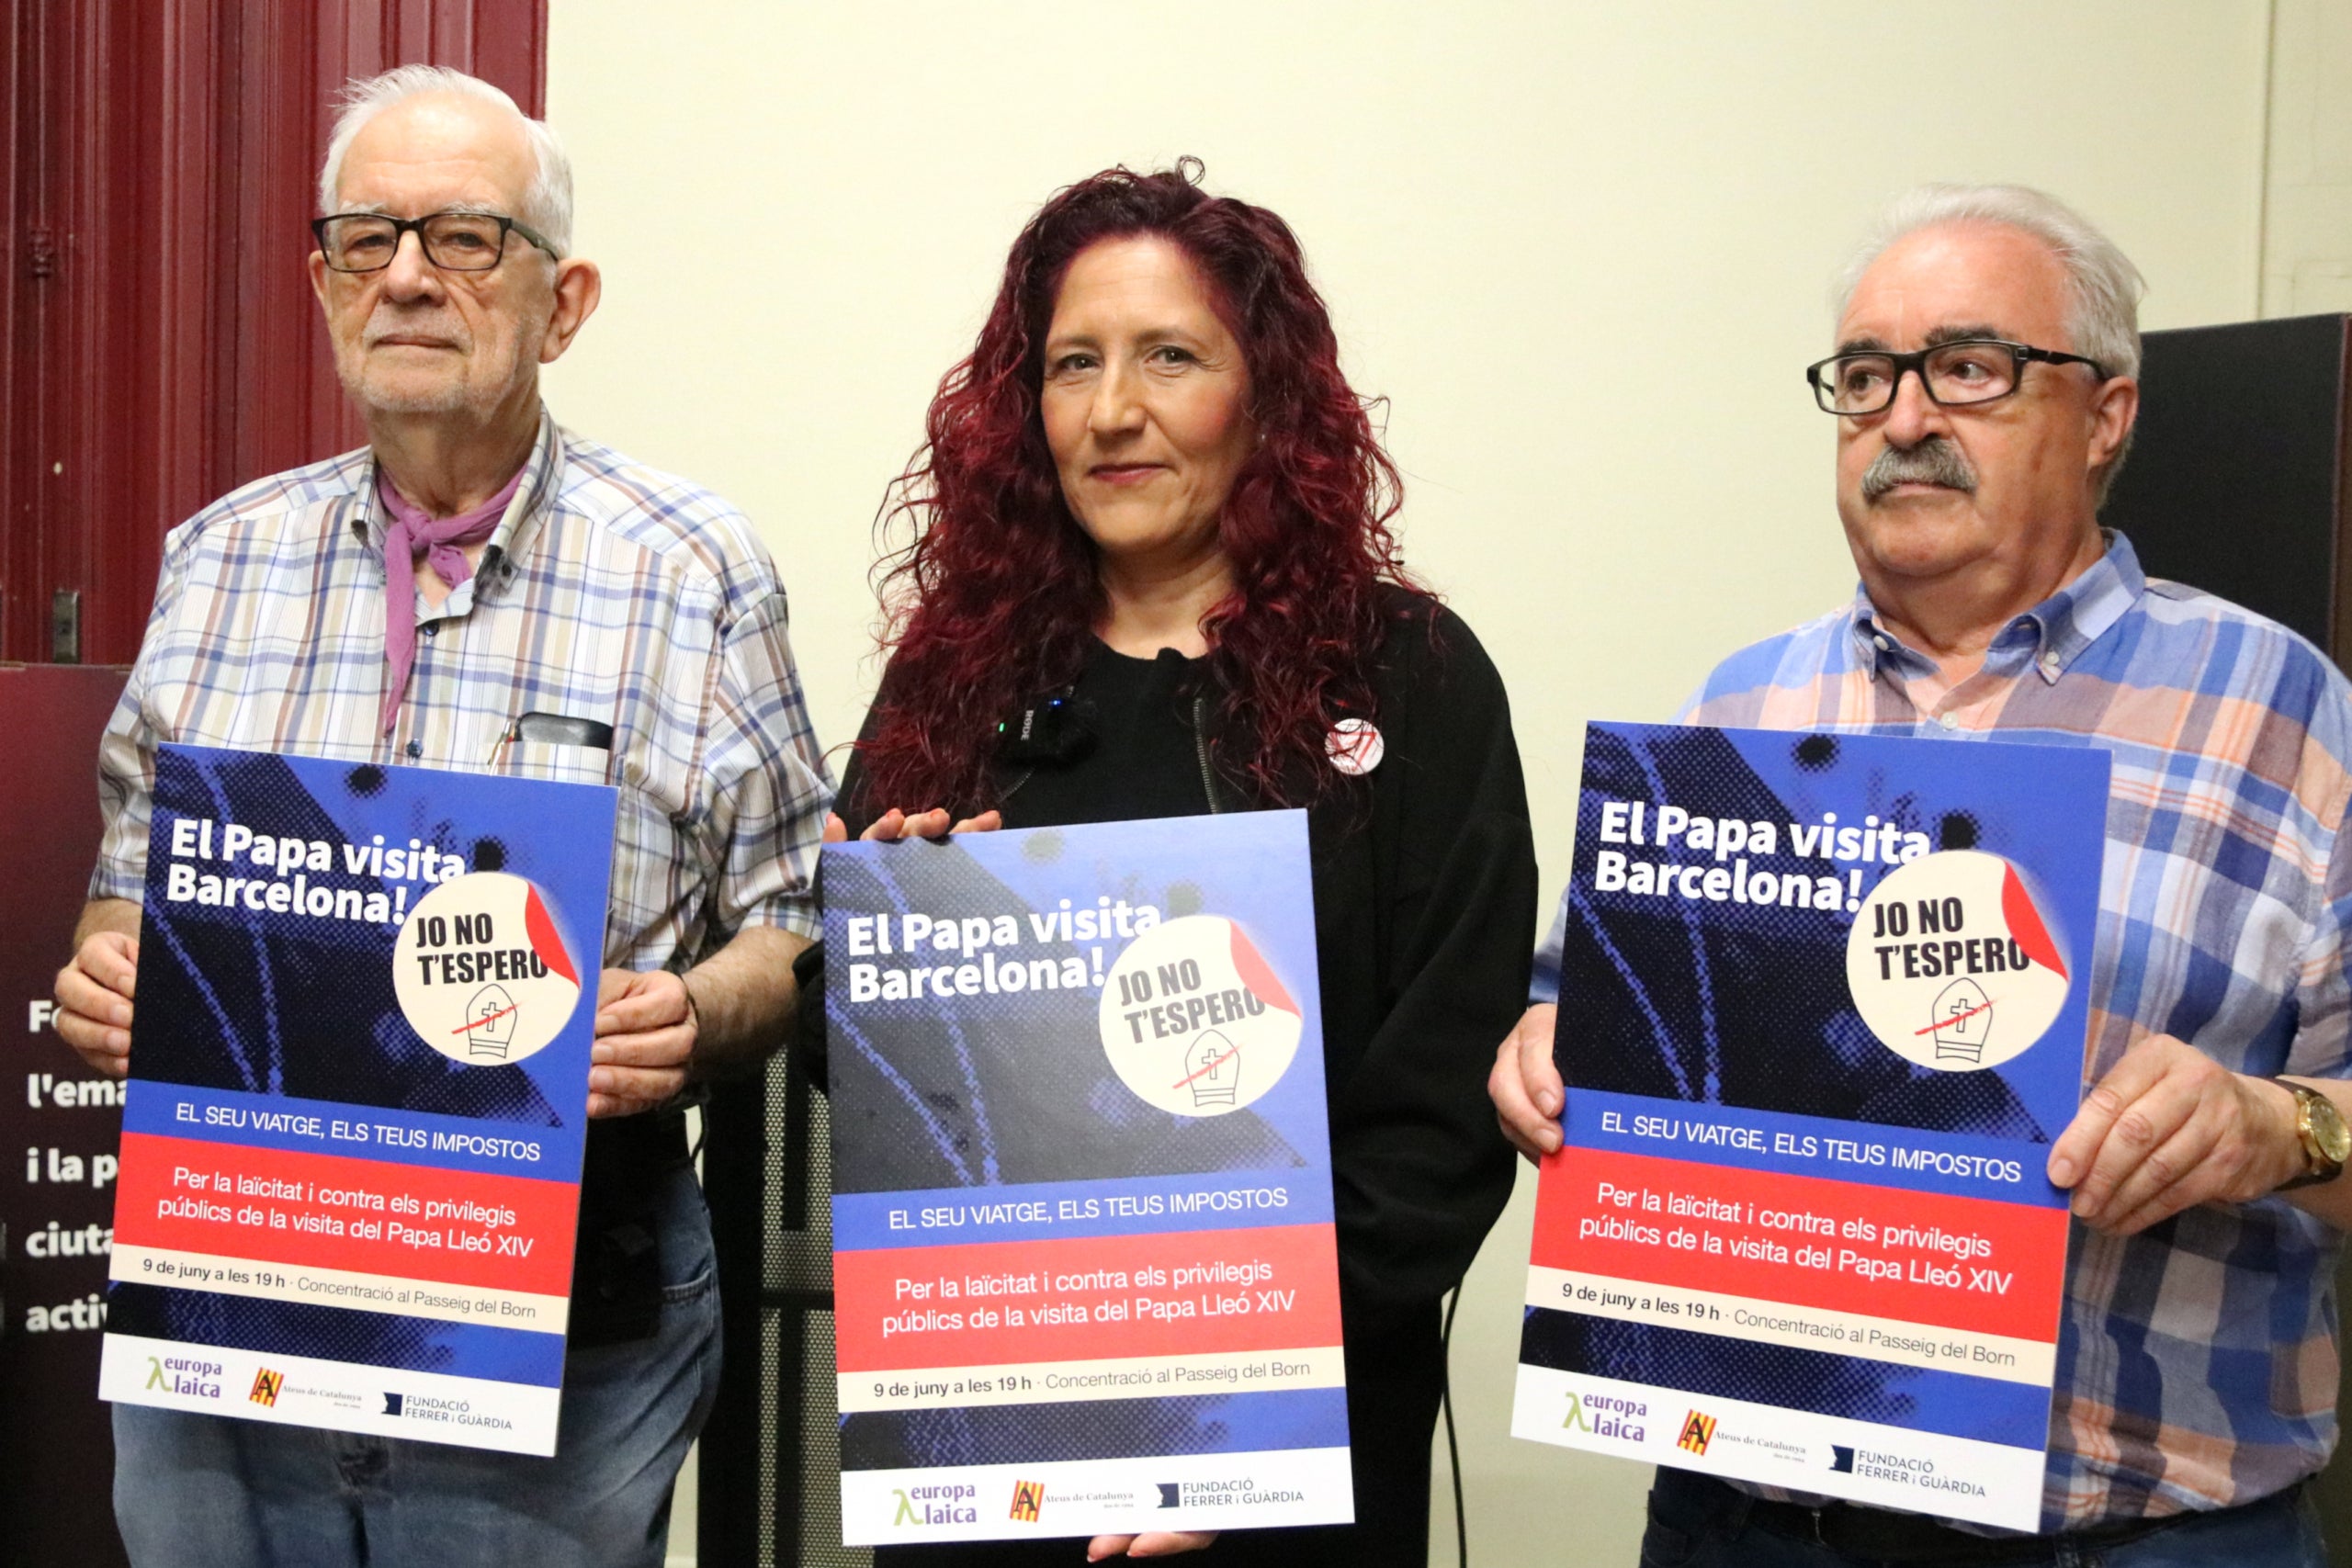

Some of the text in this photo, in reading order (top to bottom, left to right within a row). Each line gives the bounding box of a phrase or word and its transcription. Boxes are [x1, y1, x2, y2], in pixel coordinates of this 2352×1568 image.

[171, 818, 465, 883] El Papa visita
[1600, 800, 1930, 864] El Papa visita
[166, 863, 407, 925] Barcelona!
[1595, 850, 1862, 912] Barcelona!
[415, 912, 493, 949] JO NO
[848, 896, 1160, 958] El Papa visita
[1872, 896, 1963, 939] JO NO
[849, 946, 1104, 1002] Barcelona!
[1117, 958, 1202, 1007] JO NO
[175, 1101, 541, 1162] EL SEU VIATGE, ELS TEUS IMPOSTOS
[1600, 1111, 2021, 1183] EL SEU VIATGE, ELS TEUS IMPOSTOS
[27, 1147, 40, 1183] i
[47, 1147, 85, 1183] la
[173, 1166, 516, 1229] Per la laïcitat i contra els privilegis
[888, 1187, 1288, 1230] EL SEU VIATGE, ELS TEUS IMPOSTOS
[157, 1195, 534, 1258] públics de la visita del Papa Lleó XIV
[1597, 1181, 1992, 1260] Per la laïcitat i contra els privilegis
[1578, 1213, 2013, 1295] públics de la visita del Papa Lleó XIV
[142, 1258, 536, 1318] 9 de juny a les 19 h Concentració al Passeig del Born
[895, 1258, 1272, 1301] Per la laïcitat i contra els privilegis
[882, 1289, 1295, 1338] públics de la visita del Papa Lleó XIV
[1562, 1282, 2015, 1366] 9 de juny a les 19 h Concentració al Passeig del Born
[164, 1358, 222, 1378] europa
[174, 1374, 220, 1398] laica
[873, 1361, 1310, 1399] 9 de juny a les 19 h Concentració al Passeig del Born
[282, 1384, 362, 1402] Ateus Catalunya
[405, 1394, 470, 1413] FUNDACIÓ
[1582, 1393, 1647, 1417] europa
[404, 1406, 513, 1430] FERRER GUÀRDIA
[1593, 1413, 1645, 1442] laica
[1715, 1430, 1806, 1454] Ateus de Catalunya
[1858, 1450, 1934, 1473] FUNDACIÓ
[910, 1484, 976, 1501] europa
[1045, 1491, 1134, 1503] Ateus de Catalunya
[1182, 1478, 1254, 1494] FUNDACIÓ
[1183, 1491, 1305, 1507] FERRER GUÀRDIA
[1856, 1463, 1985, 1497] FERRER GUÀRDIA
[924, 1499, 977, 1525] laica
